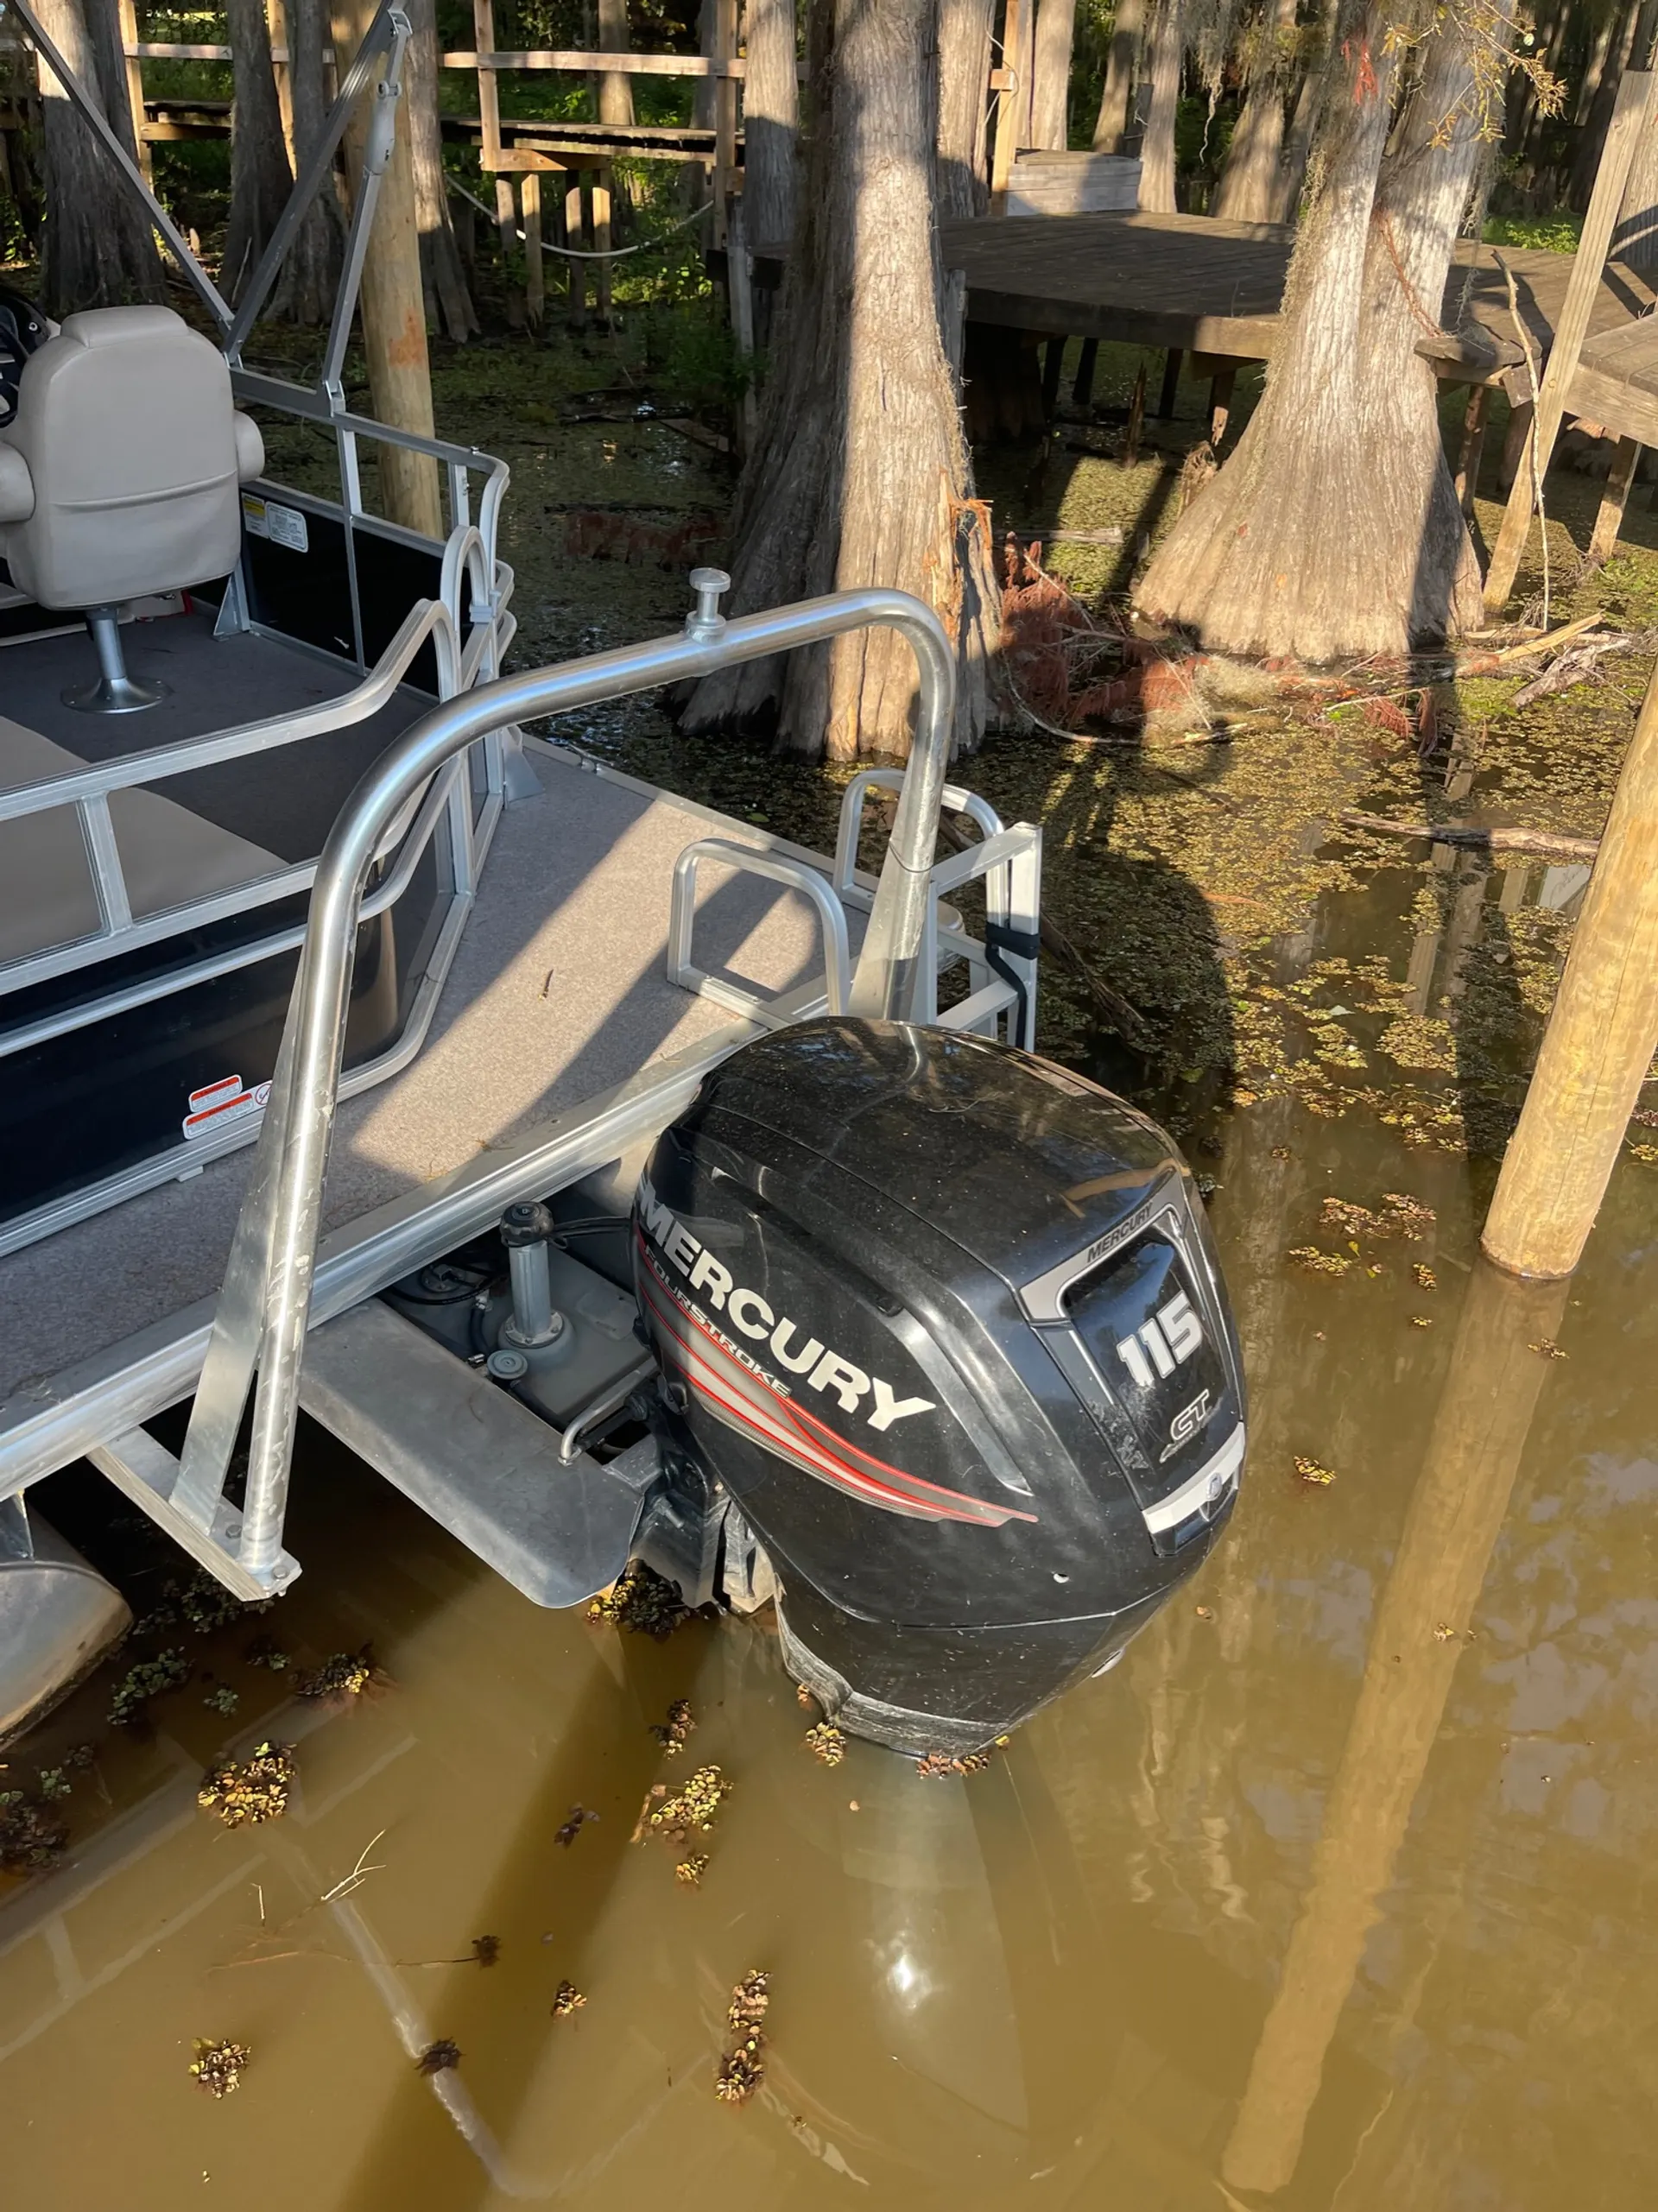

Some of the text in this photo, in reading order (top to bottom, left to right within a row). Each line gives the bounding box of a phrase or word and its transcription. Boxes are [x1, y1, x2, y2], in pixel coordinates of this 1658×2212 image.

[1086, 1201, 1154, 1263] MERCURY
[636, 1173, 935, 1431] MERCURY
[644, 1244, 793, 1398] FOURSTROKE
[1116, 1289, 1203, 1387] 115
